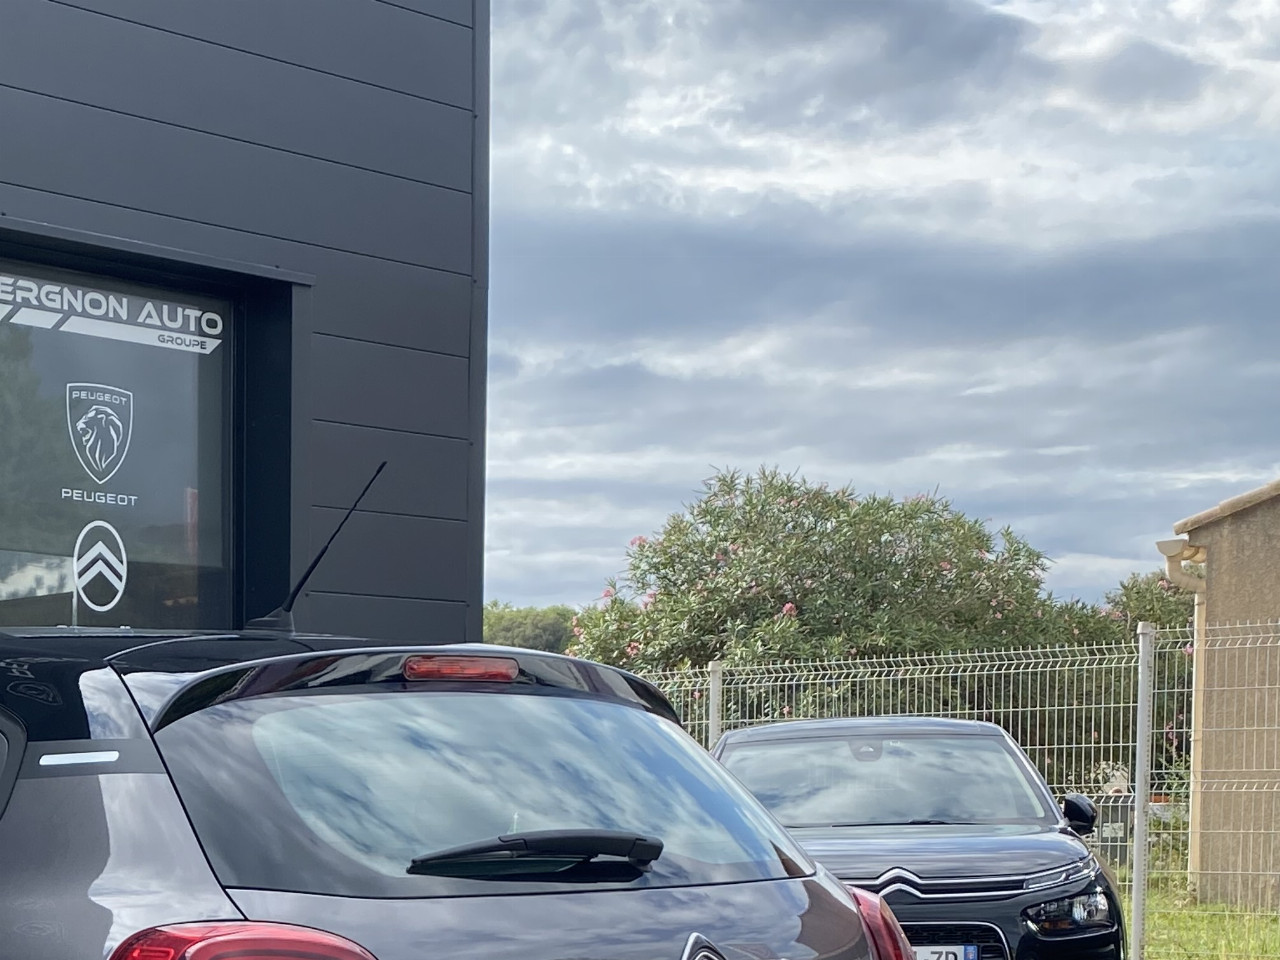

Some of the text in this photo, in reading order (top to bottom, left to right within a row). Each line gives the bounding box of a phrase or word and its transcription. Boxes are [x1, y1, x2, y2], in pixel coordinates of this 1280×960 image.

[137, 301, 223, 335] AUTO
[157, 333, 208, 350] GROUPE
[71, 390, 128, 406] PEUGEOT
[61, 488, 138, 507] PEUGEOT
